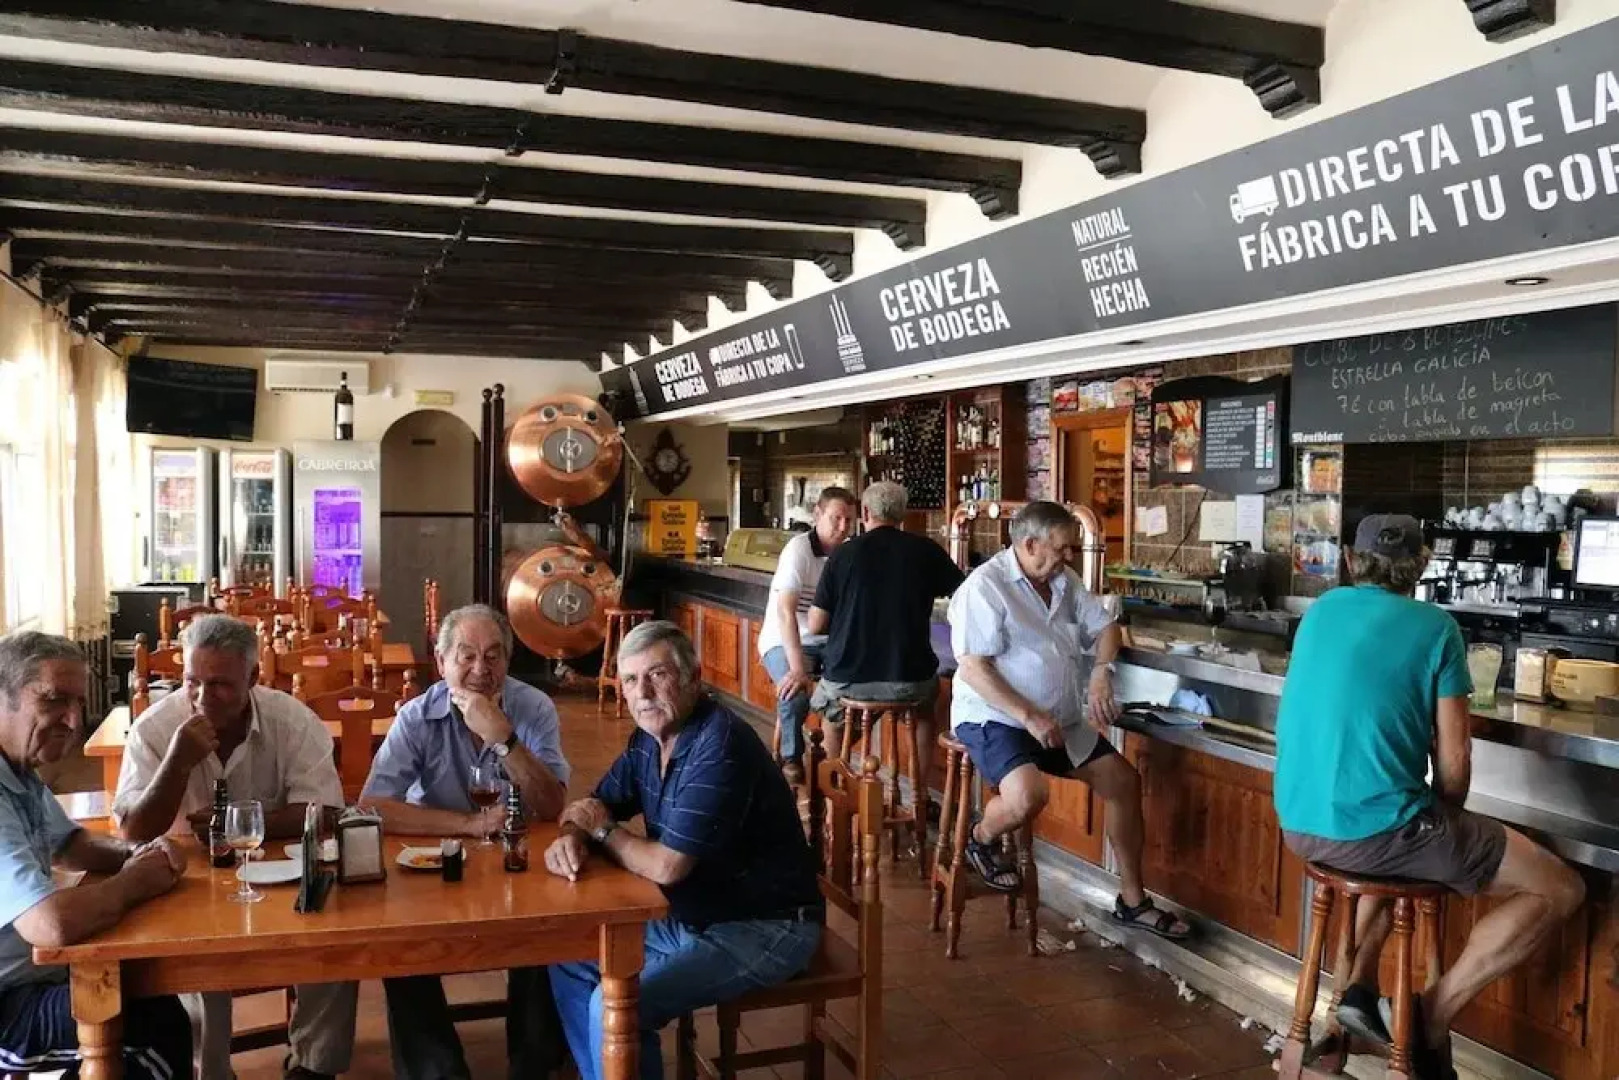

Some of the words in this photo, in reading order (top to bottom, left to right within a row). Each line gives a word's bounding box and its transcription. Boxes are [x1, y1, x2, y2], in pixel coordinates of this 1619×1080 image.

[1279, 122, 1461, 208] DIRECTA
[1470, 96, 1544, 158] DE
[1556, 70, 1619, 134] LA
[1071, 206, 1131, 247] NATURAL
[1238, 202, 1398, 272] FÁBRICA
[1408, 192, 1438, 237] A
[1443, 174, 1507, 228] TU
[1081, 242, 1139, 283] RECIÉN
[879, 258, 1001, 322] CERVEZA
[1090, 277, 1151, 318] HECHA
[889, 321, 919, 352] DE
[919, 300, 1011, 347] BODEGA
[655, 351, 703, 383] CERVEZA
[765, 352, 794, 376] COPA
[1331, 360, 1403, 390] ESTRELLA
[1414, 343, 1491, 373] GALICIA
[1456, 375, 1478, 401] de
[1456, 401, 1478, 420] de
[1527, 410, 1576, 434] acto
